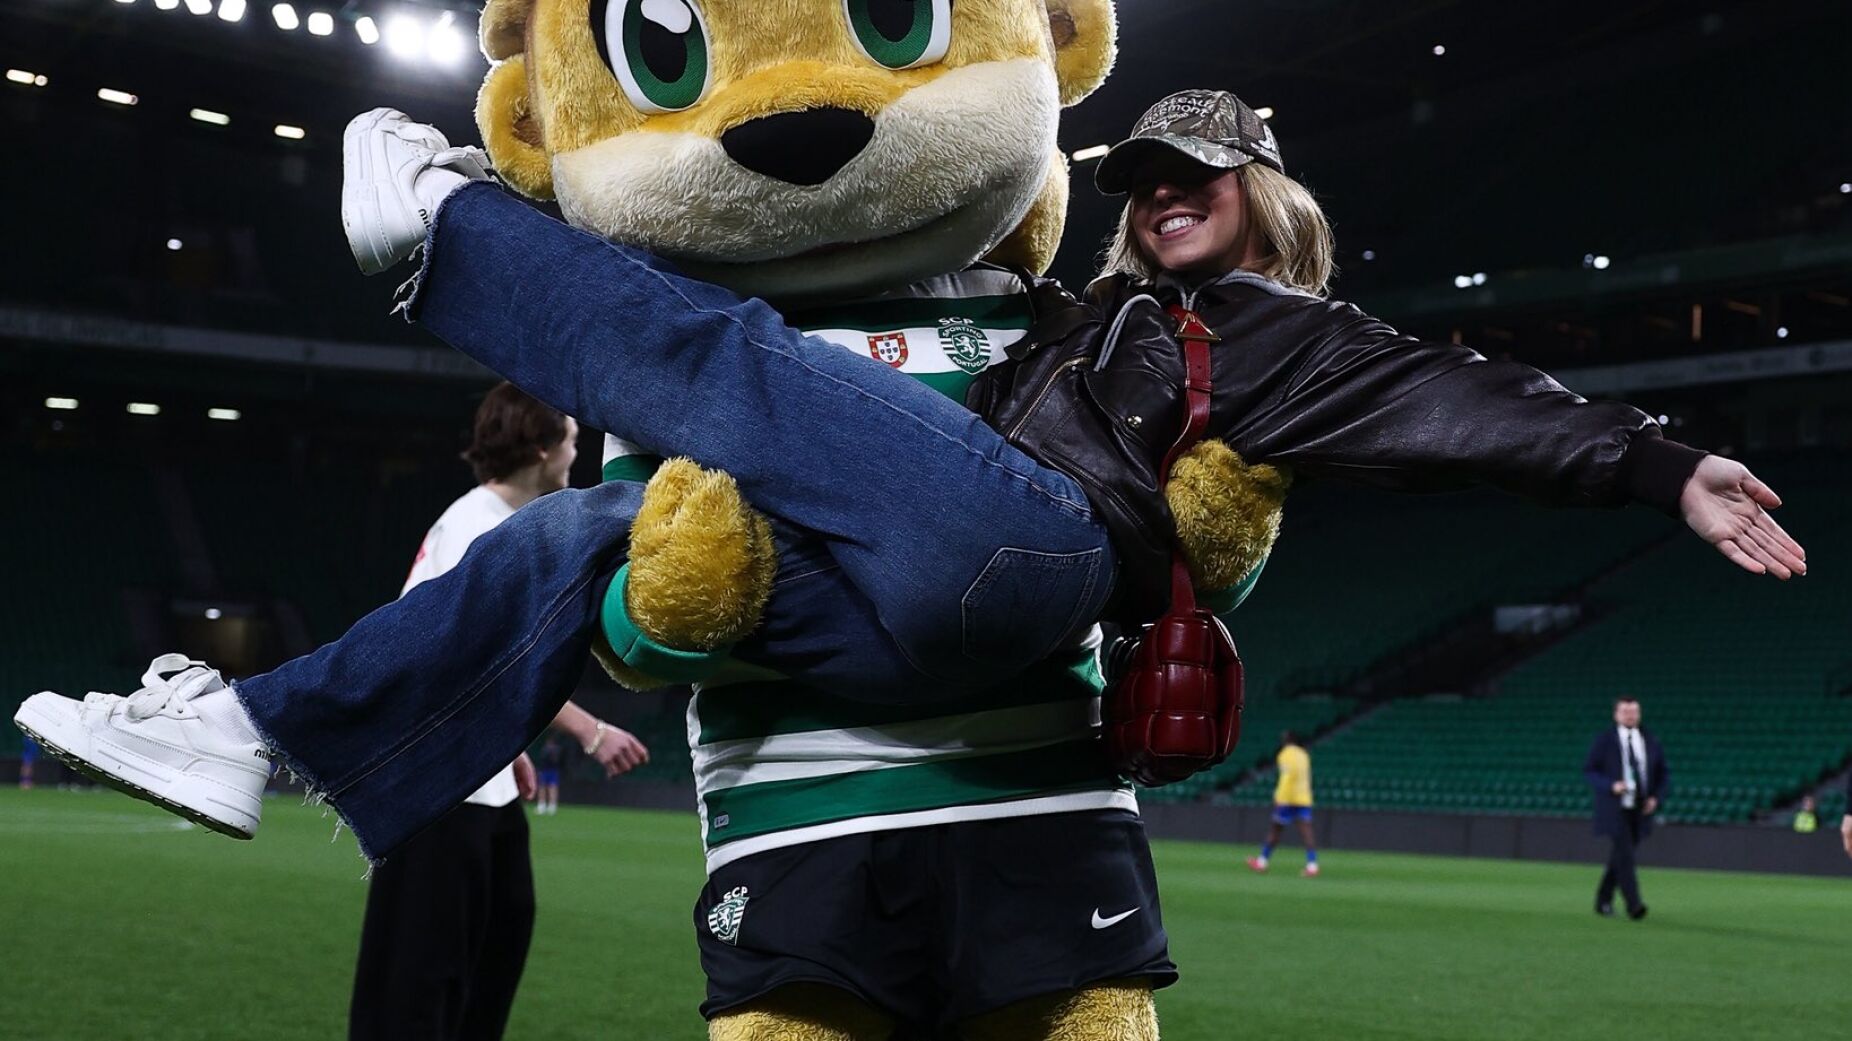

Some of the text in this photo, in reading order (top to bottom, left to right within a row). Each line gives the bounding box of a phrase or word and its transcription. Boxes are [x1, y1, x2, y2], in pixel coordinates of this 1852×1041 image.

[938, 316, 974, 326] SCP
[942, 326, 983, 339] SPORTING
[951, 356, 987, 368] PORTUGAL
[723, 886, 748, 903] SCP
